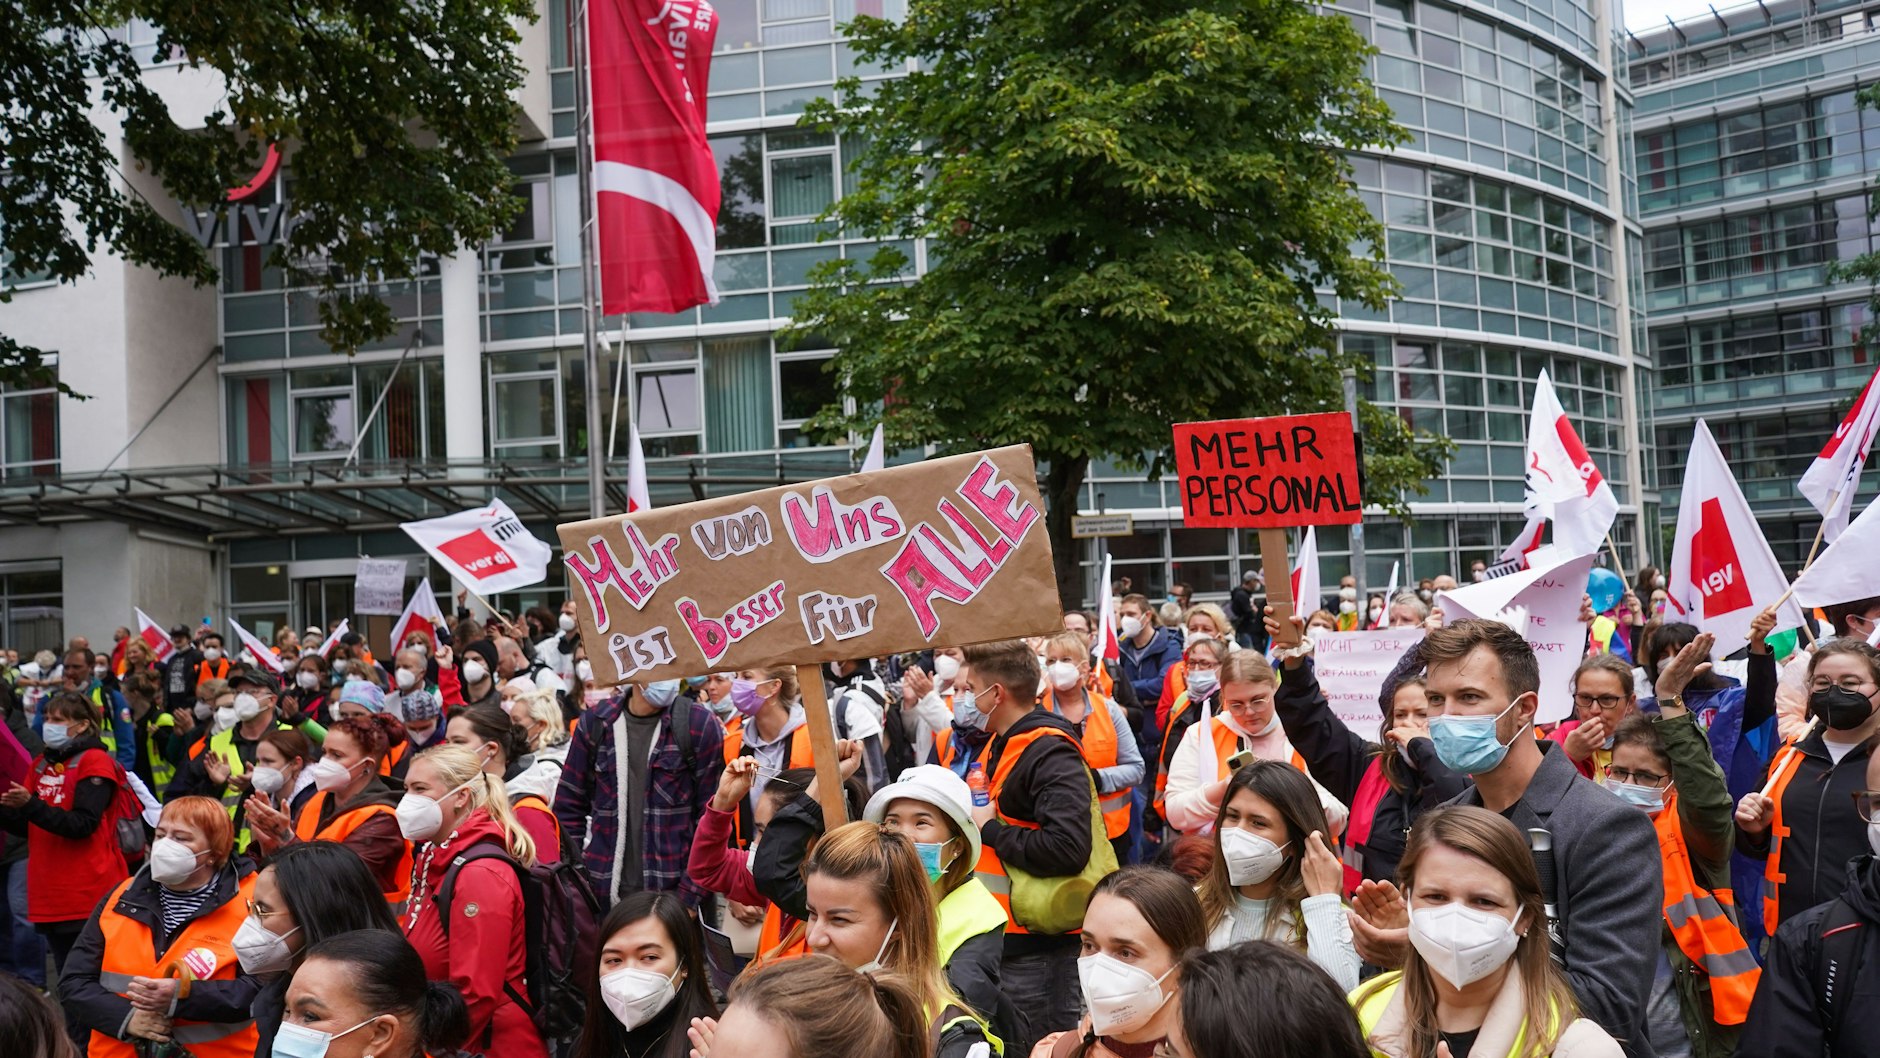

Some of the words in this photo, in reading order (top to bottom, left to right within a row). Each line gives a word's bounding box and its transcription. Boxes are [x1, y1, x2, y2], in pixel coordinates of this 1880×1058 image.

[1190, 425, 1324, 470] MEHR
[1185, 472, 1361, 517] PERSONAL
[785, 492, 901, 557] Uns
[464, 550, 511, 572] ver.di
[677, 582, 785, 659] Besser
[802, 593, 876, 641] Für
[883, 461, 1038, 638] ALLE
[1530, 615, 1546, 627] TE
[1318, 638, 1357, 653] NICHT
[1372, 639, 1404, 652] DER
[1529, 641, 1565, 652] PART
[1325, 693, 1374, 701] ONDERN
[1825, 959, 1838, 1004] FORVERT
